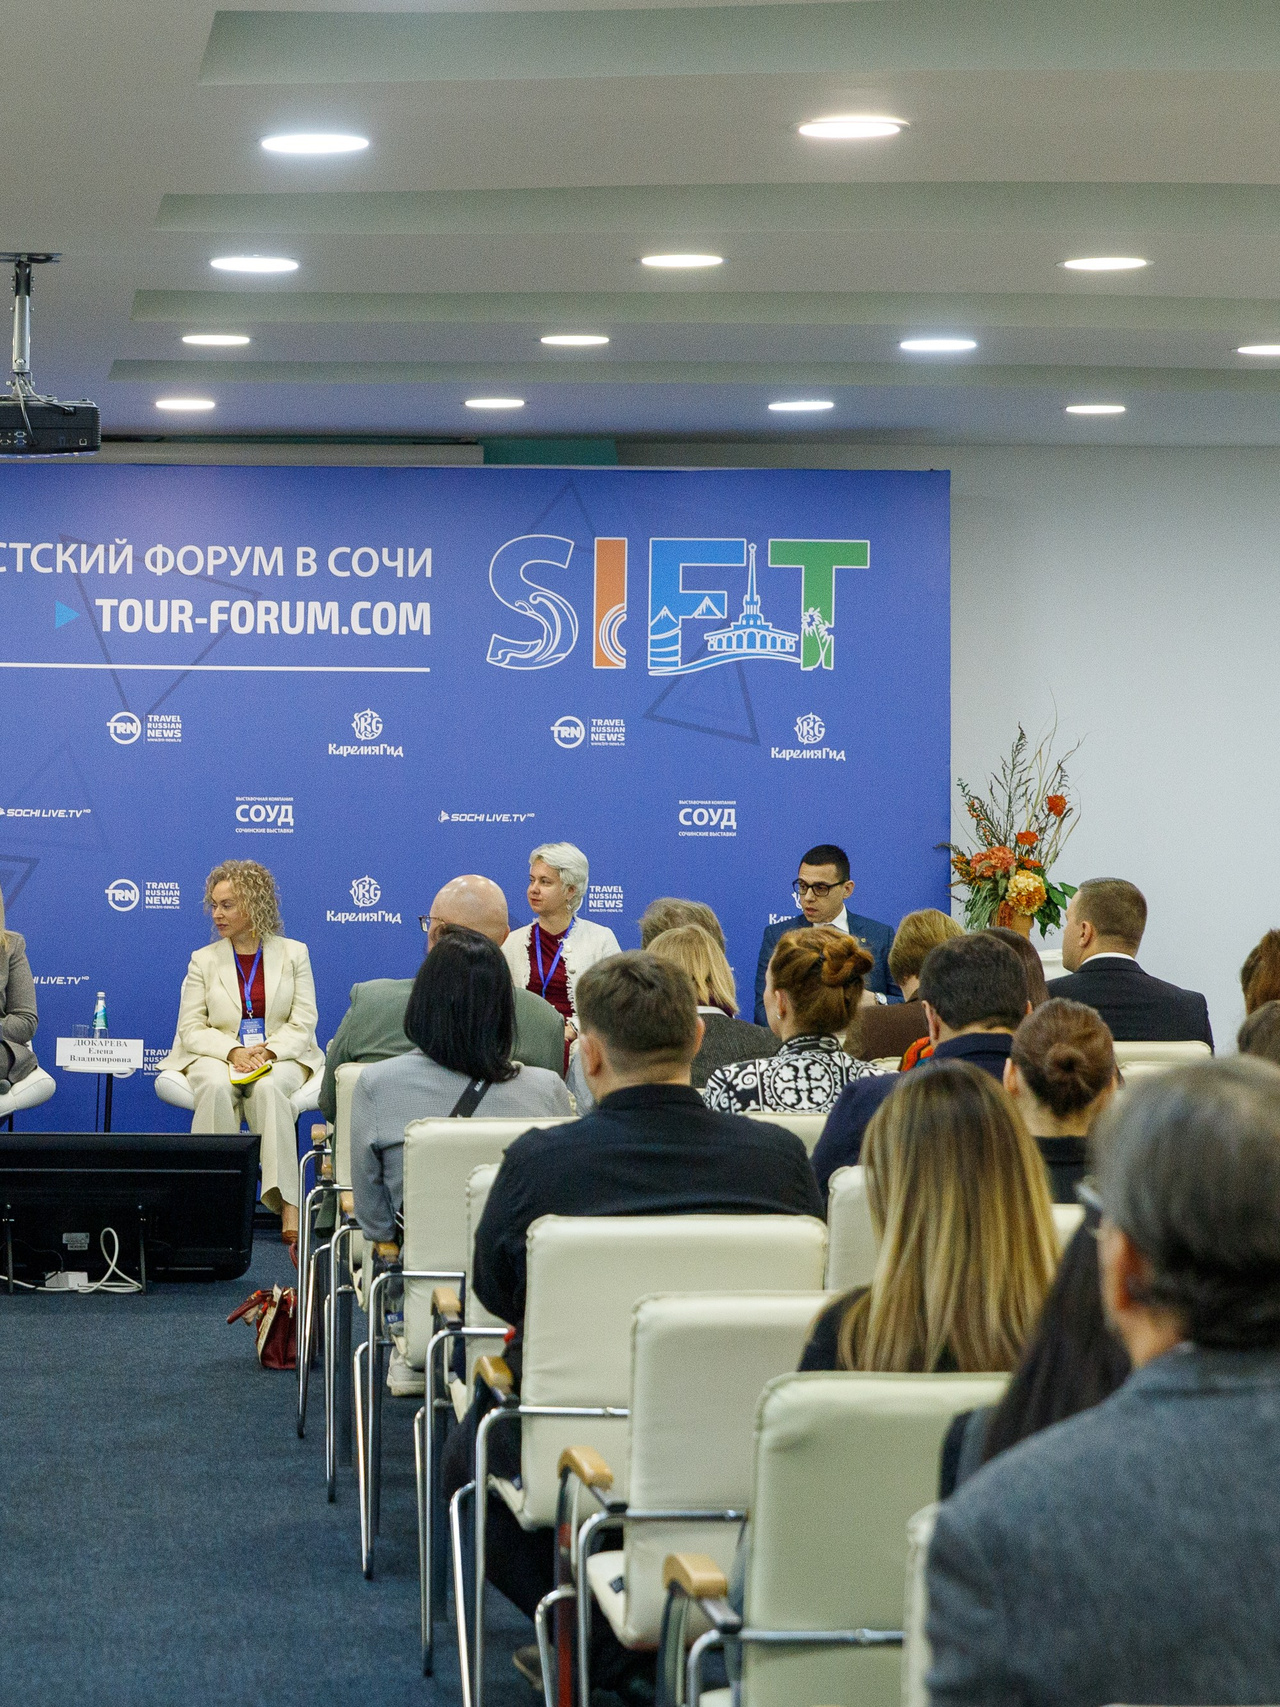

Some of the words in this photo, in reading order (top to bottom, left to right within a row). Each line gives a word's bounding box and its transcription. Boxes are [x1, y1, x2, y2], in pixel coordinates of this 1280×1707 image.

[144, 543, 284, 577] ФОРУМ
[296, 546, 318, 577] В
[327, 546, 432, 578] СОЧИ
[487, 534, 870, 676] SIFT
[95, 599, 431, 636] TOUR-FORUM.COM
[147, 729, 182, 737] NEWS
[591, 733, 625, 741] NEWS
[328, 743, 404, 758] КарелияГид
[771, 747, 846, 761] КарелияГид
[6, 808, 40, 817] SOCHI
[41, 809, 82, 818] LIVE.TV
[235, 804, 294, 826] СОУД
[450, 813, 485, 822] SOCHI
[486, 813, 527, 822] LIVE.TV
[679, 808, 737, 829] СОУД
[145, 896, 180, 905] NEWS
[589, 900, 623, 908] NEWS
[326, 910, 402, 924] КарелияГид
[40, 976, 81, 985] LIVE.TV
[88, 1047, 114, 1055] Елена
[69, 1055, 132, 1064] Владимировна
[144, 1063, 158, 1071] NE
